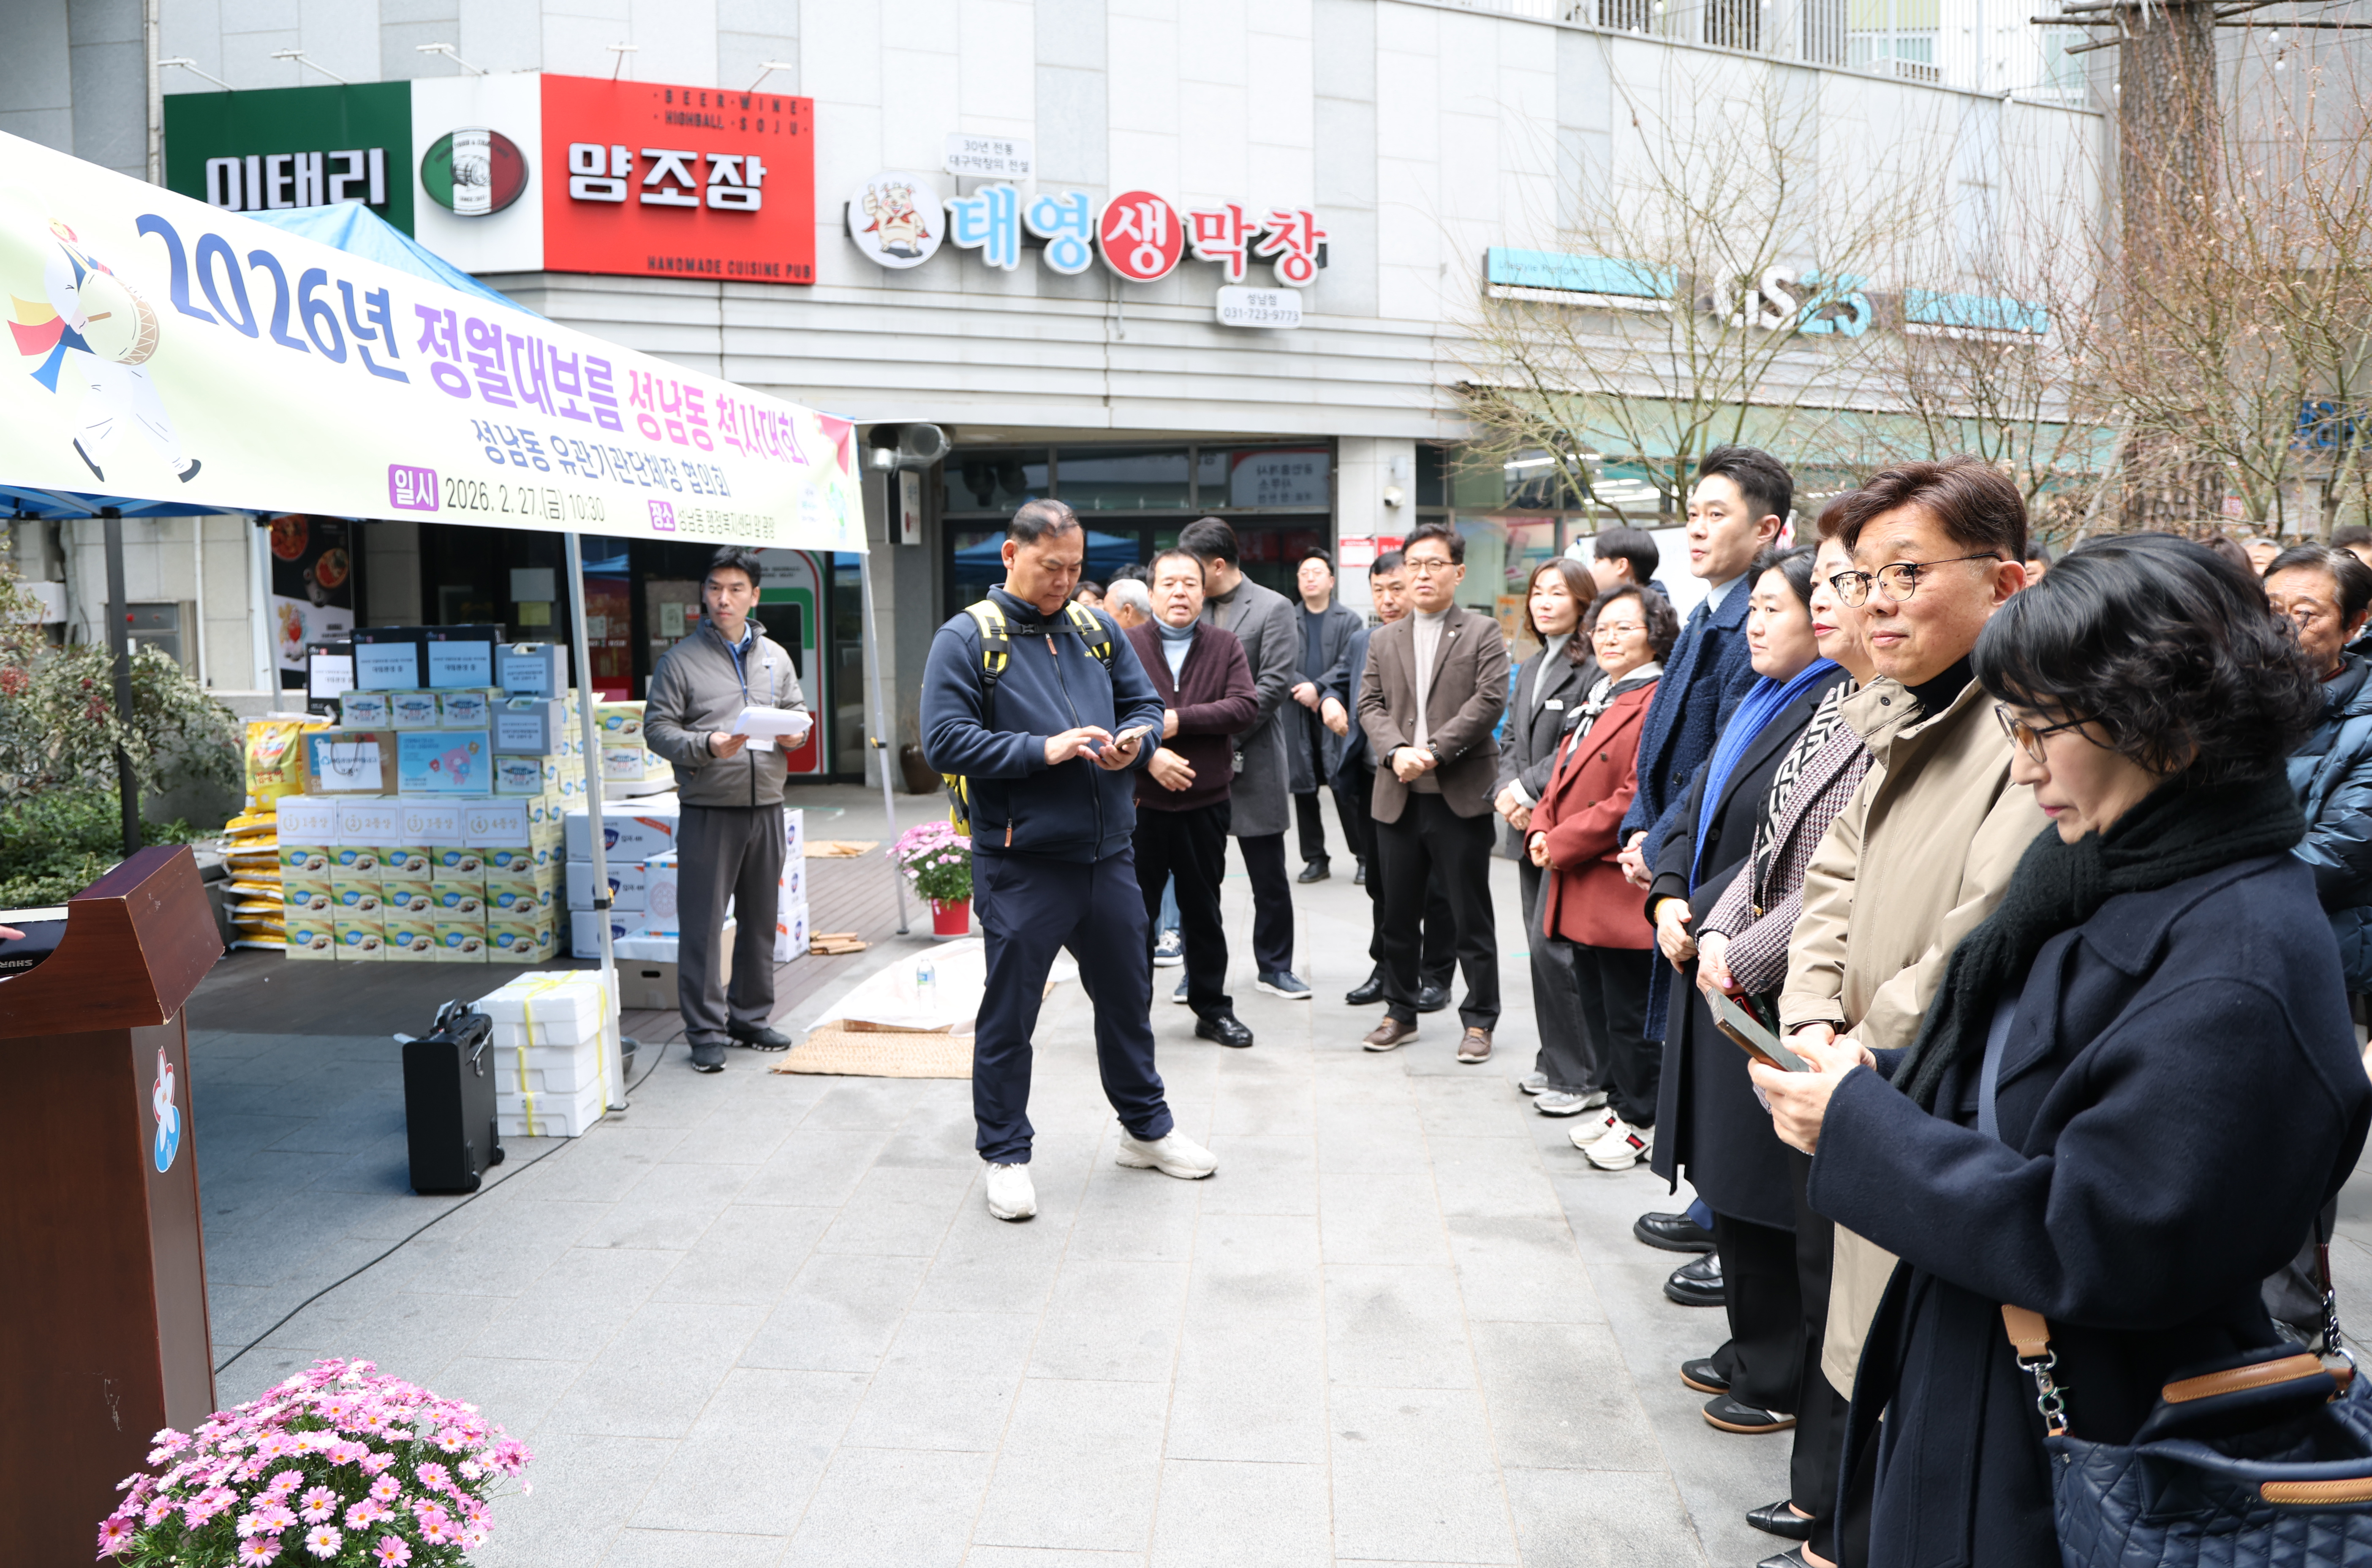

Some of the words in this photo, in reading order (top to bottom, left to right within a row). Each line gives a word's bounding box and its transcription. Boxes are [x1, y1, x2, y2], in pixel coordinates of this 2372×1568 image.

[666, 89, 724, 107] BEER
[740, 95, 797, 114] WINE
[665, 110, 724, 129] HIGHBALL
[740, 117, 797, 135] SOJU
[964, 140, 988, 153] 30년
[949, 155, 1004, 169] 대구막창의
[1008, 159, 1028, 172] 전설
[206, 147, 386, 212] 이태리
[569, 142, 767, 212] 양조장
[950, 186, 1327, 280] 태영생막창
[648, 255, 721, 274] HANDMADE
[727, 259, 779, 277] CUISINE
[786, 263, 811, 278] PUB
[1247, 293, 1277, 307] 성남점
[1713, 261, 1871, 337] GS25
[1224, 306, 1300, 322] 031-723-9773
[135, 214, 411, 384] 2026년
[414, 303, 624, 432] 정월대보름
[629, 369, 714, 452] 성남동
[716, 393, 809, 466] 척사대회
[470, 419, 550, 472] 성남동
[550, 435, 683, 492] 유관기관단체장
[681, 459, 731, 497] 협의회
[394, 468, 435, 507] 일시
[446, 477, 494, 511] 2026.
[500, 484, 514, 514] 2.
[519, 487, 565, 521] 27.(금)
[569, 494, 604, 522] 10:30
[650, 501, 674, 530] 장소
[677, 506, 705, 533] 성남동
[706, 510, 752, 536] 행정복지센터
[303, 817, 328, 828] 1등상
[365, 817, 391, 829] 2등상
[427, 817, 453, 829] 3등상
[491, 818, 517, 829] 4등상
